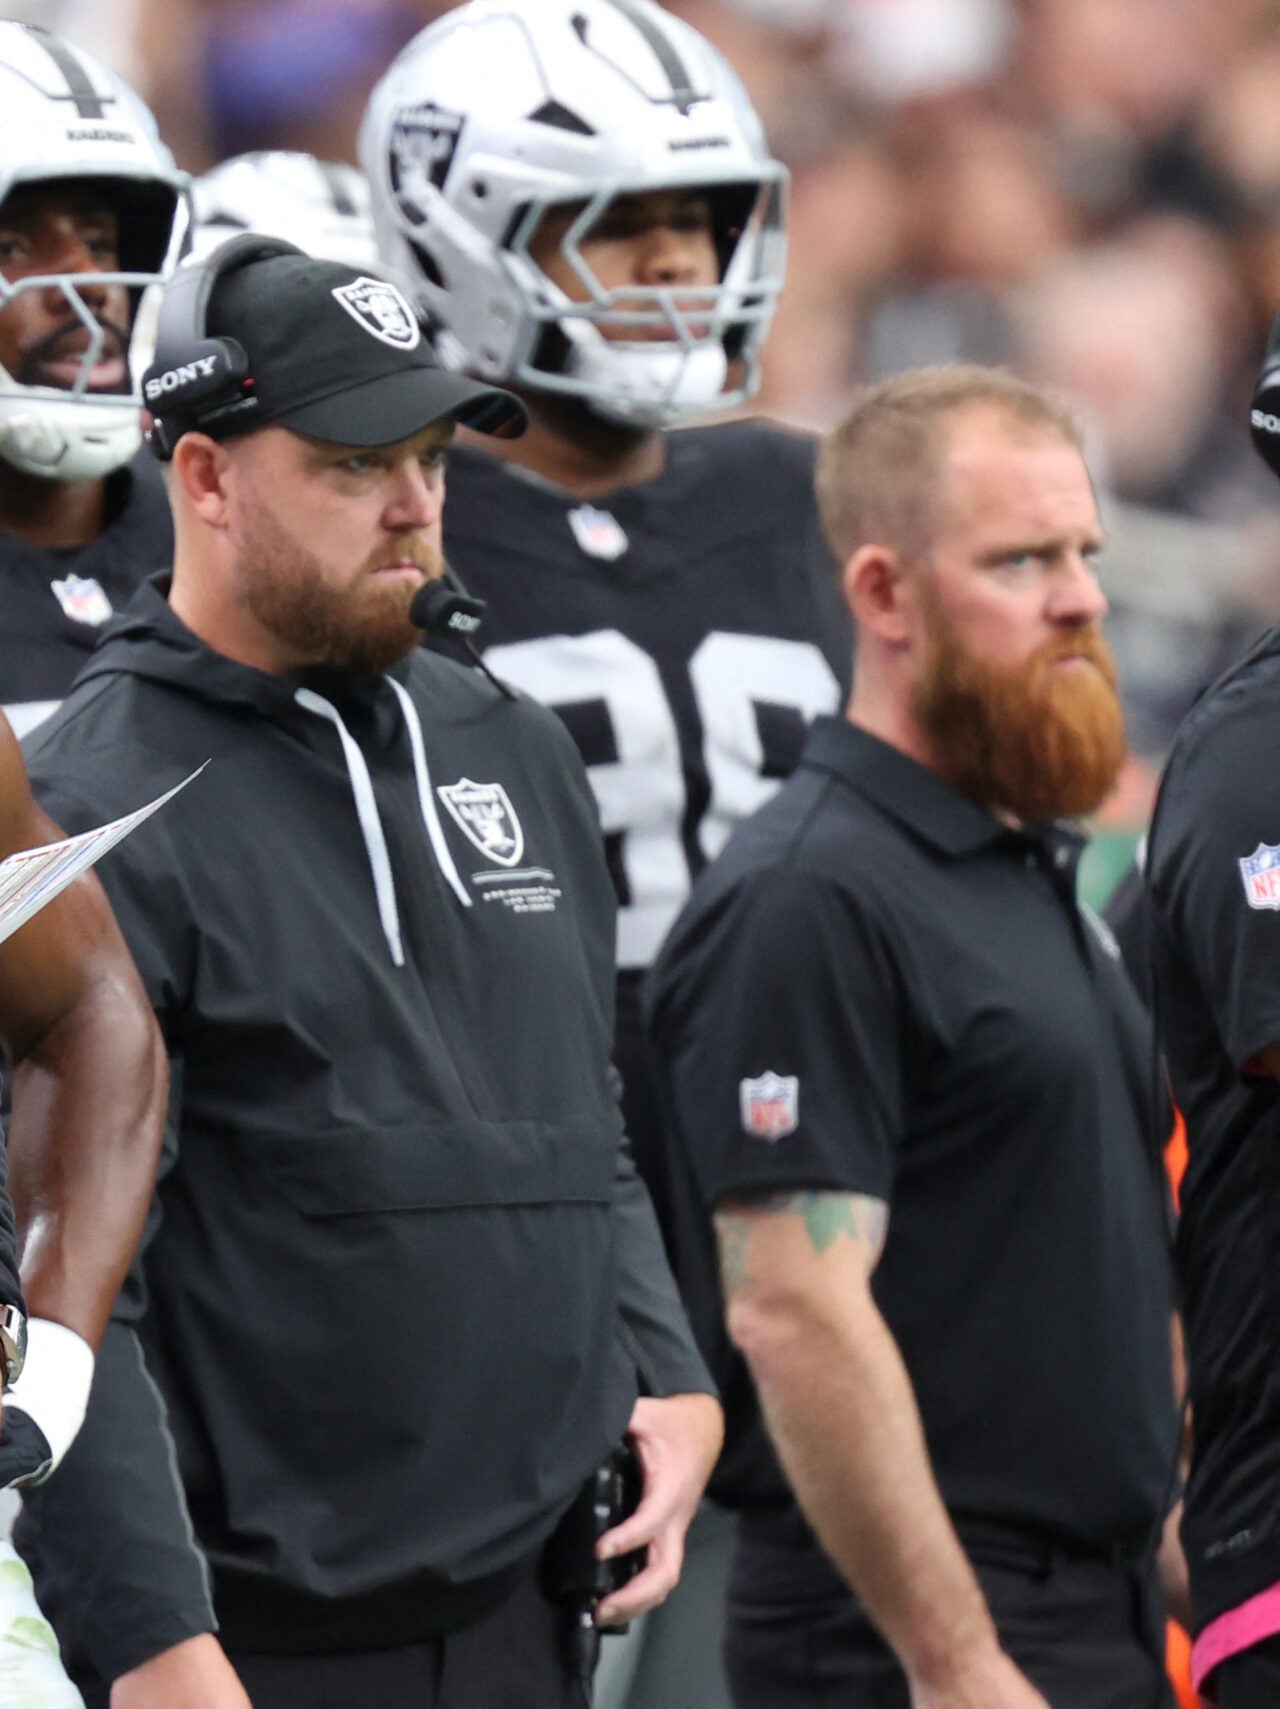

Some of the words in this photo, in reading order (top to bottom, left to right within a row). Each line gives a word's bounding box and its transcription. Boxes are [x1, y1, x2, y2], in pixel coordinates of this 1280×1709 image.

[145, 355, 218, 400] SONY
[1251, 409, 1280, 434] SO
[1251, 867, 1280, 899] NF
